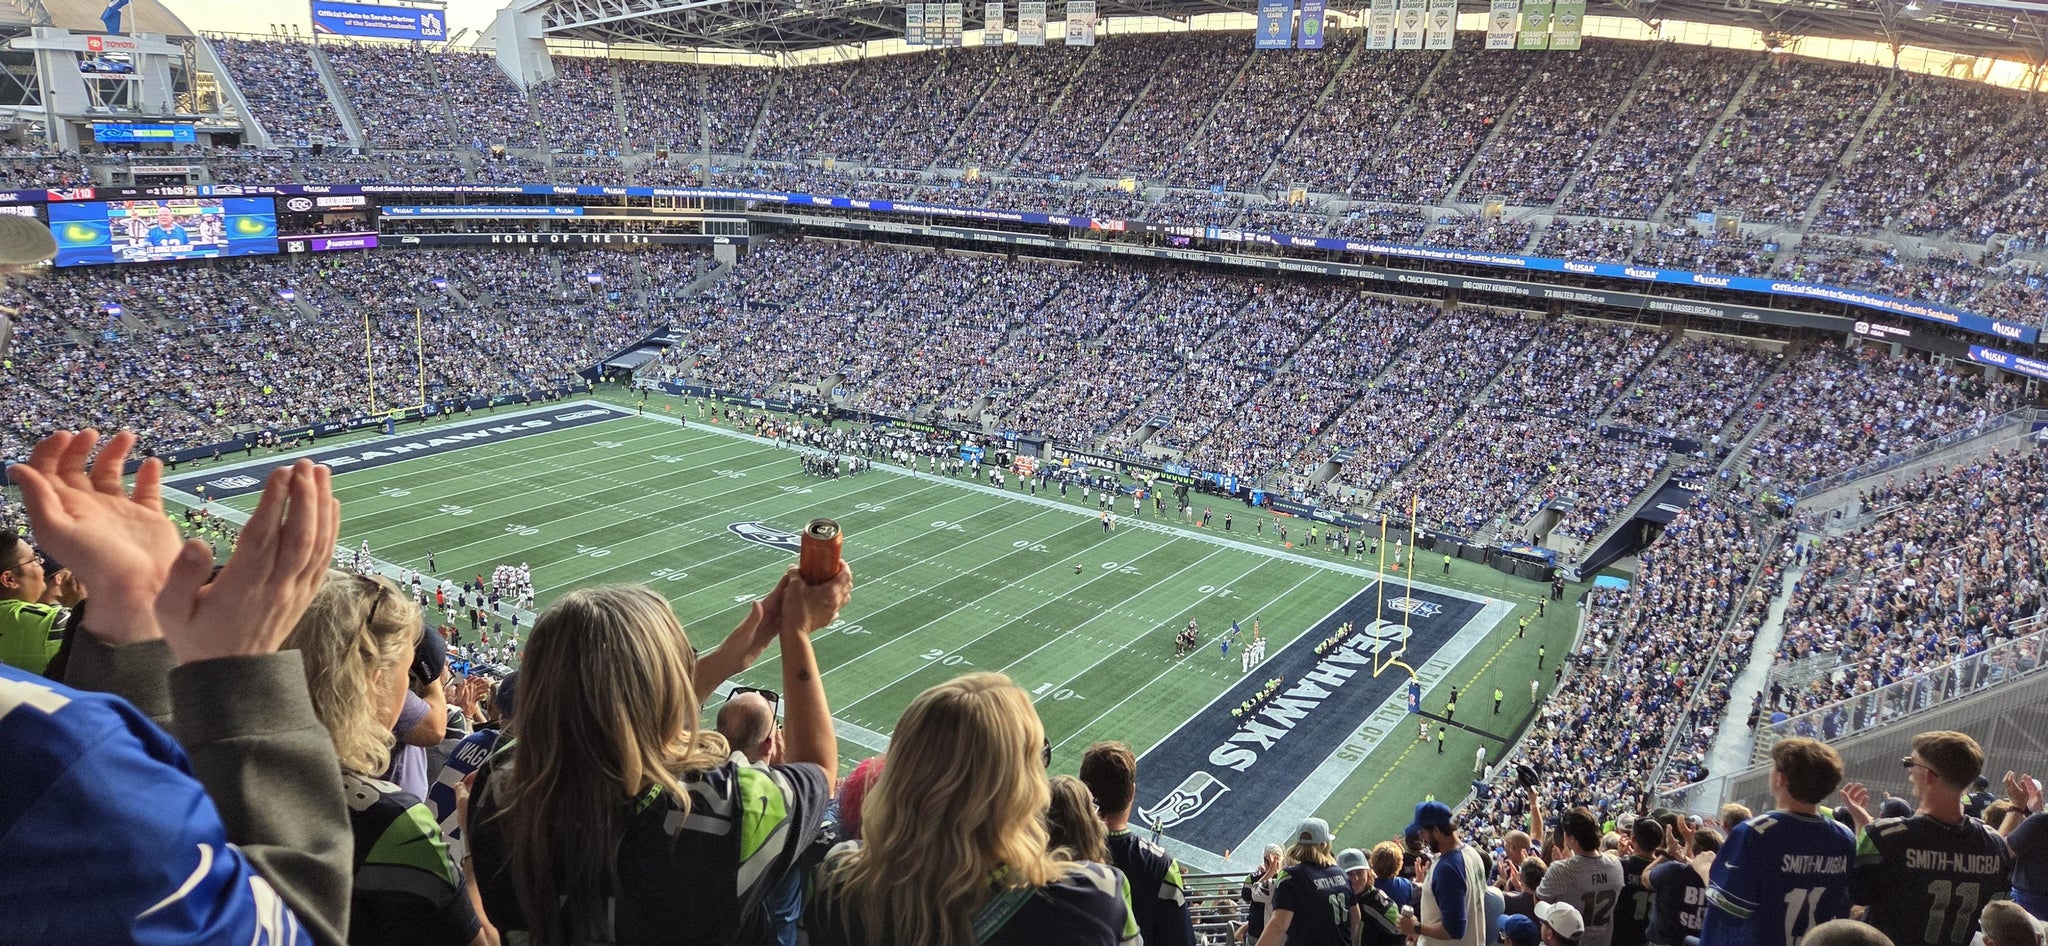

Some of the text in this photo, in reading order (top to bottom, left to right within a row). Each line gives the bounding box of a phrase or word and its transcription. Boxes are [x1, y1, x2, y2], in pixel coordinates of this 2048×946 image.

[1493, 2, 1517, 10] SHIELD
[318, 9, 342, 18] Official
[342, 11, 362, 19] Salute
[370, 13, 392, 21] Service
[392, 15, 416, 23] Partner
[362, 20, 386, 28] Seattle
[386, 22, 416, 30] Seahawks
[421, 28, 442, 36] USAA
[492, 234, 539, 243] HOME
[550, 235, 570, 243] OF
[582, 235, 611, 243] THE
[1299, 238, 1316, 247] USAA
[1346, 242, 1369, 251] Official
[1369, 244, 1389, 253] Salute
[1398, 247, 1420, 256] Service
[1421, 249, 1445, 258] Partner
[1446, 251, 1453, 259] of
[1454, 252, 1465, 260] the
[1467, 254, 1490, 263] Seattle
[1492, 257, 1526, 265] Seahawks
[1285, 263, 1301, 271] KENNY
[1574, 264, 1595, 273] USAA
[1406, 275, 1438, 286] CHUCK KNOX
[1636, 270, 1658, 279] USAA
[1472, 282, 1516, 293] CORTEZ KENNEDY
[1706, 277, 1729, 287] USAA
[1552, 290, 1574, 300] WALTER
[1574, 293, 1592, 302] JONES
[1771, 282, 1959, 322] Official Salute to Service Partner of the Seattle Seahawks
[1656, 302, 1672, 311] MATT
[1672, 304, 1711, 315] HASSELBECK
[2001, 326, 2021, 338] USAA
[1989, 352, 2006, 364] USAA
[324, 420, 358, 431] SEATLE
[318, 418, 553, 468] EAHAWKS
[1678, 480, 1704, 492] LUM
[505, 523, 540, 536] 30
[576, 543, 612, 558] 40
[650, 567, 689, 582] 50
[1100, 561, 1138, 576] 20
[920, 648, 963, 667] 20
[1032, 682, 1074, 701] 10
[1208, 618, 1413, 772] SEAHAWKS
[1372, 702, 1406, 723] ALL
[1357, 726, 1384, 743] OF
[1336, 743, 1367, 762] US
[1781, 853, 1848, 875] SMITH-NJIGBA
[1906, 848, 2001, 876] SMITH-NJIGBA
[1313, 874, 1347, 891] SMITH-NJIGBA
[1591, 872, 1608, 886] FAN
[1328, 892, 1349, 926] 11
[1580, 889, 1617, 927] 12
[1924, 879, 1981, 945] 11
[1783, 886, 1827, 946] 11
